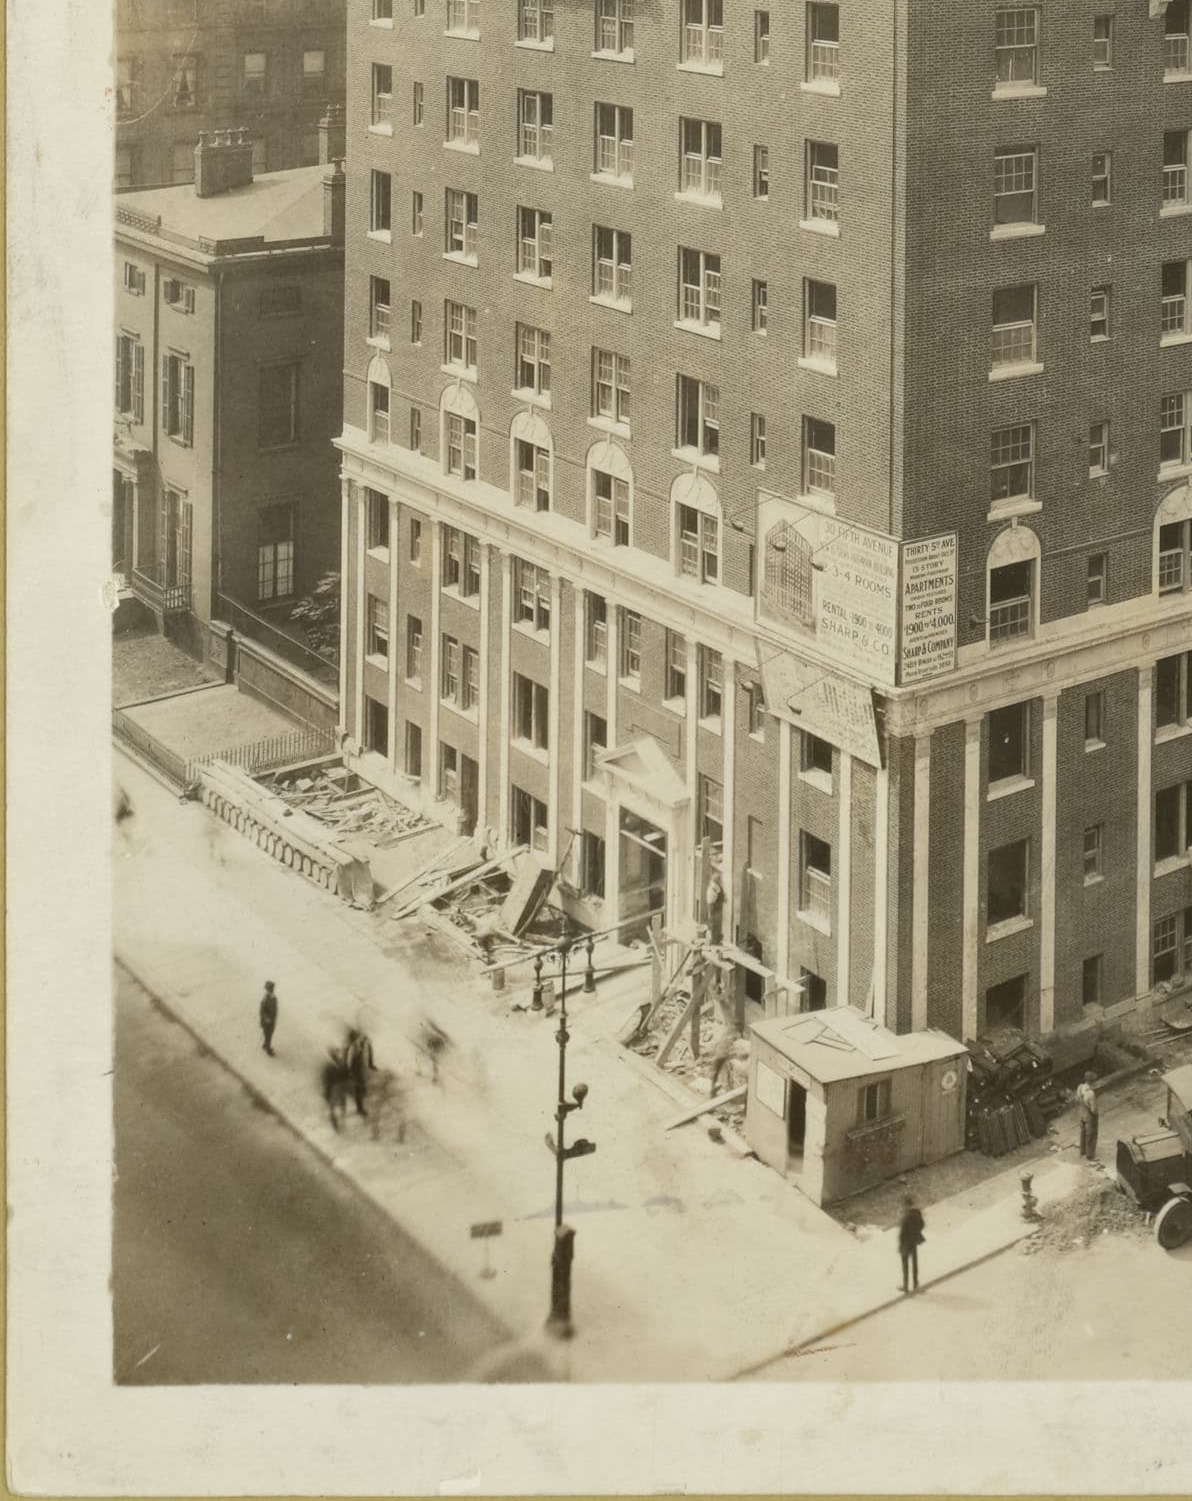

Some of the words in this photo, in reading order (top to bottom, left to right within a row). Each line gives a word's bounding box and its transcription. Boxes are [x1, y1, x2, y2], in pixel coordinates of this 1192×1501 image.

[863, 536, 892, 557] AVENUE
[905, 544, 928, 557] THIRTY
[855, 574, 892, 597] ROOMS
[904, 574, 954, 597] APARTMENTS
[822, 598, 847, 622] RENTAL
[915, 607, 943, 621] RENTS
[820, 616, 859, 641] SHARP
[927, 638, 954, 653] COMPANY
